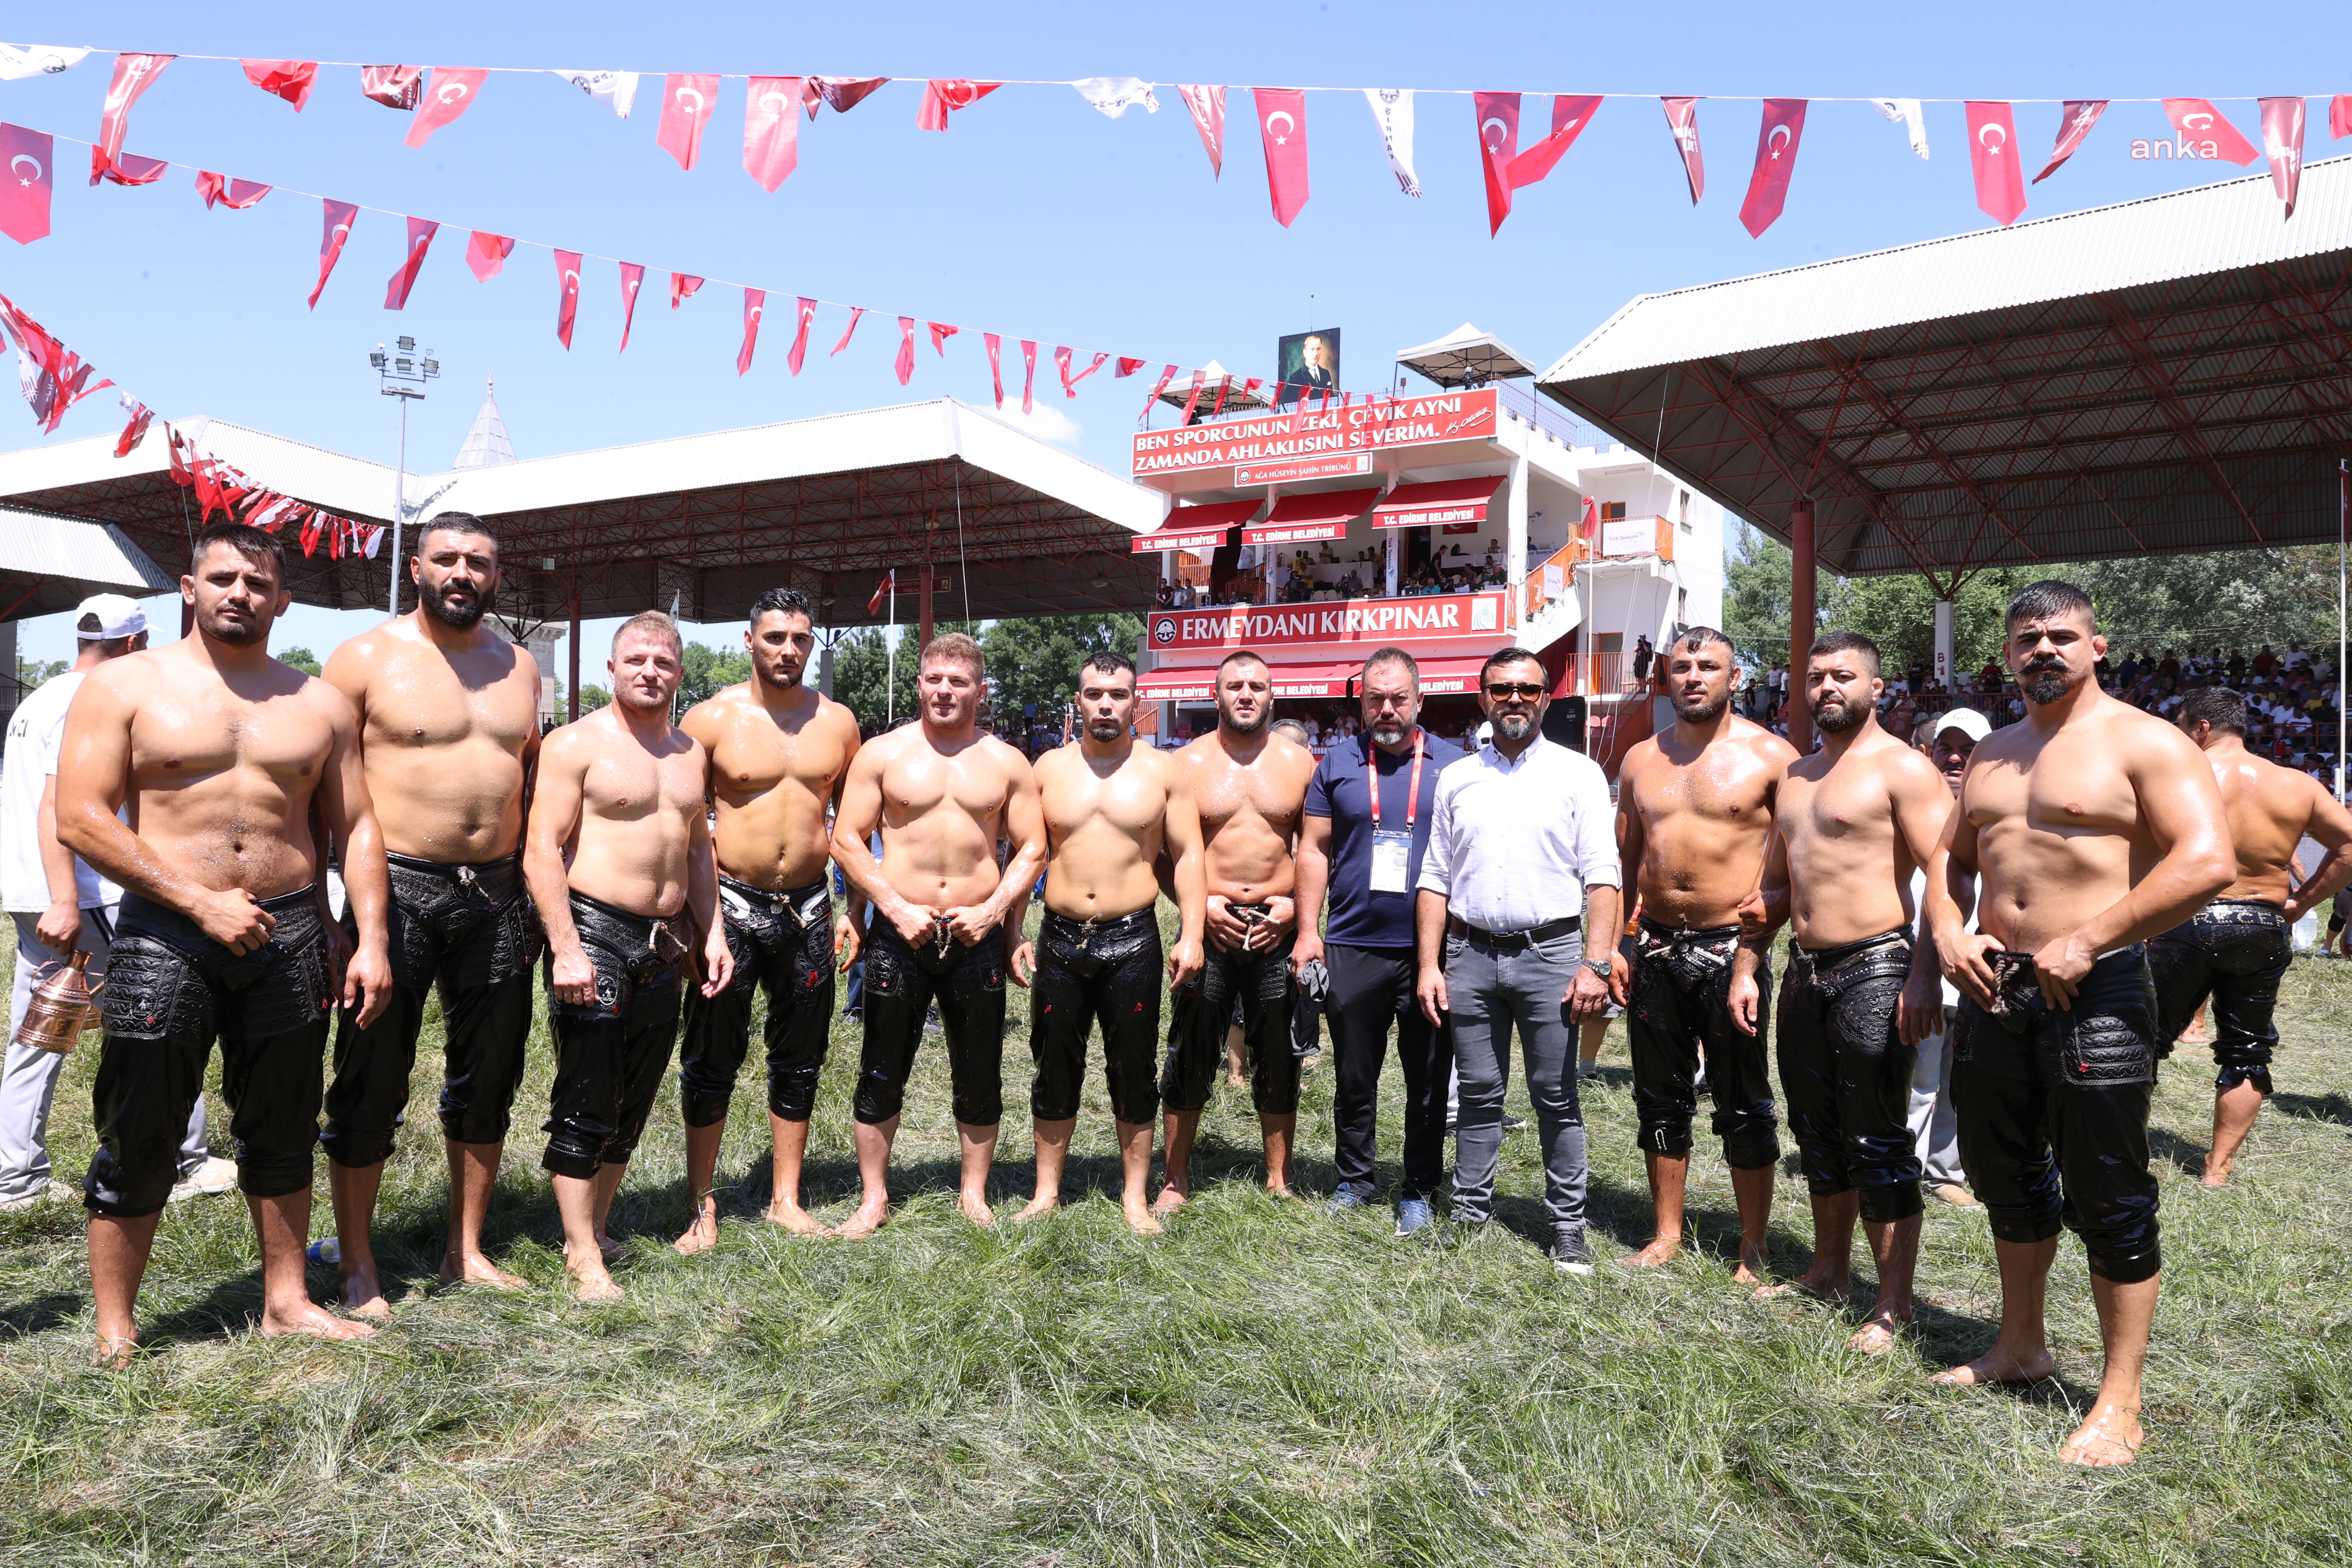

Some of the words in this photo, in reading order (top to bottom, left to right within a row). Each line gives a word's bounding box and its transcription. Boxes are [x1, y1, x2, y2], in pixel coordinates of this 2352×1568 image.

[1137, 435, 1168, 452] BEN
[1173, 420, 1290, 447] SPORCUNUN
[1349, 402, 1408, 429] ÇEVİK
[1412, 397, 1461, 418] AYNI
[1135, 448, 1223, 472] ZAMANDA
[1227, 435, 1343, 461] AHLAKLISINI
[1349, 422, 1440, 446] SEVERİM.
[1254, 471, 1268, 479] AĞA
[1269, 468, 1297, 478] HÜSEYİN
[1298, 466, 1319, 477] ŞAHİN
[1321, 463, 1351, 475] TRİBÜNÜ
[1384, 516, 1396, 525] T.C.
[1399, 513, 1427, 524] EDİRNE
[1428, 508, 1474, 522] BELEDİYESİ
[1142, 541, 1153, 549] T.C.
[1154, 538, 1178, 548] EDİRNE
[1179, 533, 1217, 546] BELEDİYESİ
[1252, 533, 1265, 542] T.C.
[1266, 530, 1292, 542] EDİRNE
[1293, 526, 1335, 539] BELEDİYESİ
[1182, 612, 1314, 640] ERMEYDANI
[1321, 603, 1459, 634] KIRKPINAR
[1938, 652, 1945, 662] B
[1146, 688, 1170, 698] EDİRNE
[1171, 686, 1210, 697] BELEDİYESİ
[1271, 686, 1285, 695] RNE
[1286, 683, 1328, 695] BELEDİYESİ
[1419, 679, 1464, 691] BELEDİYESİ
